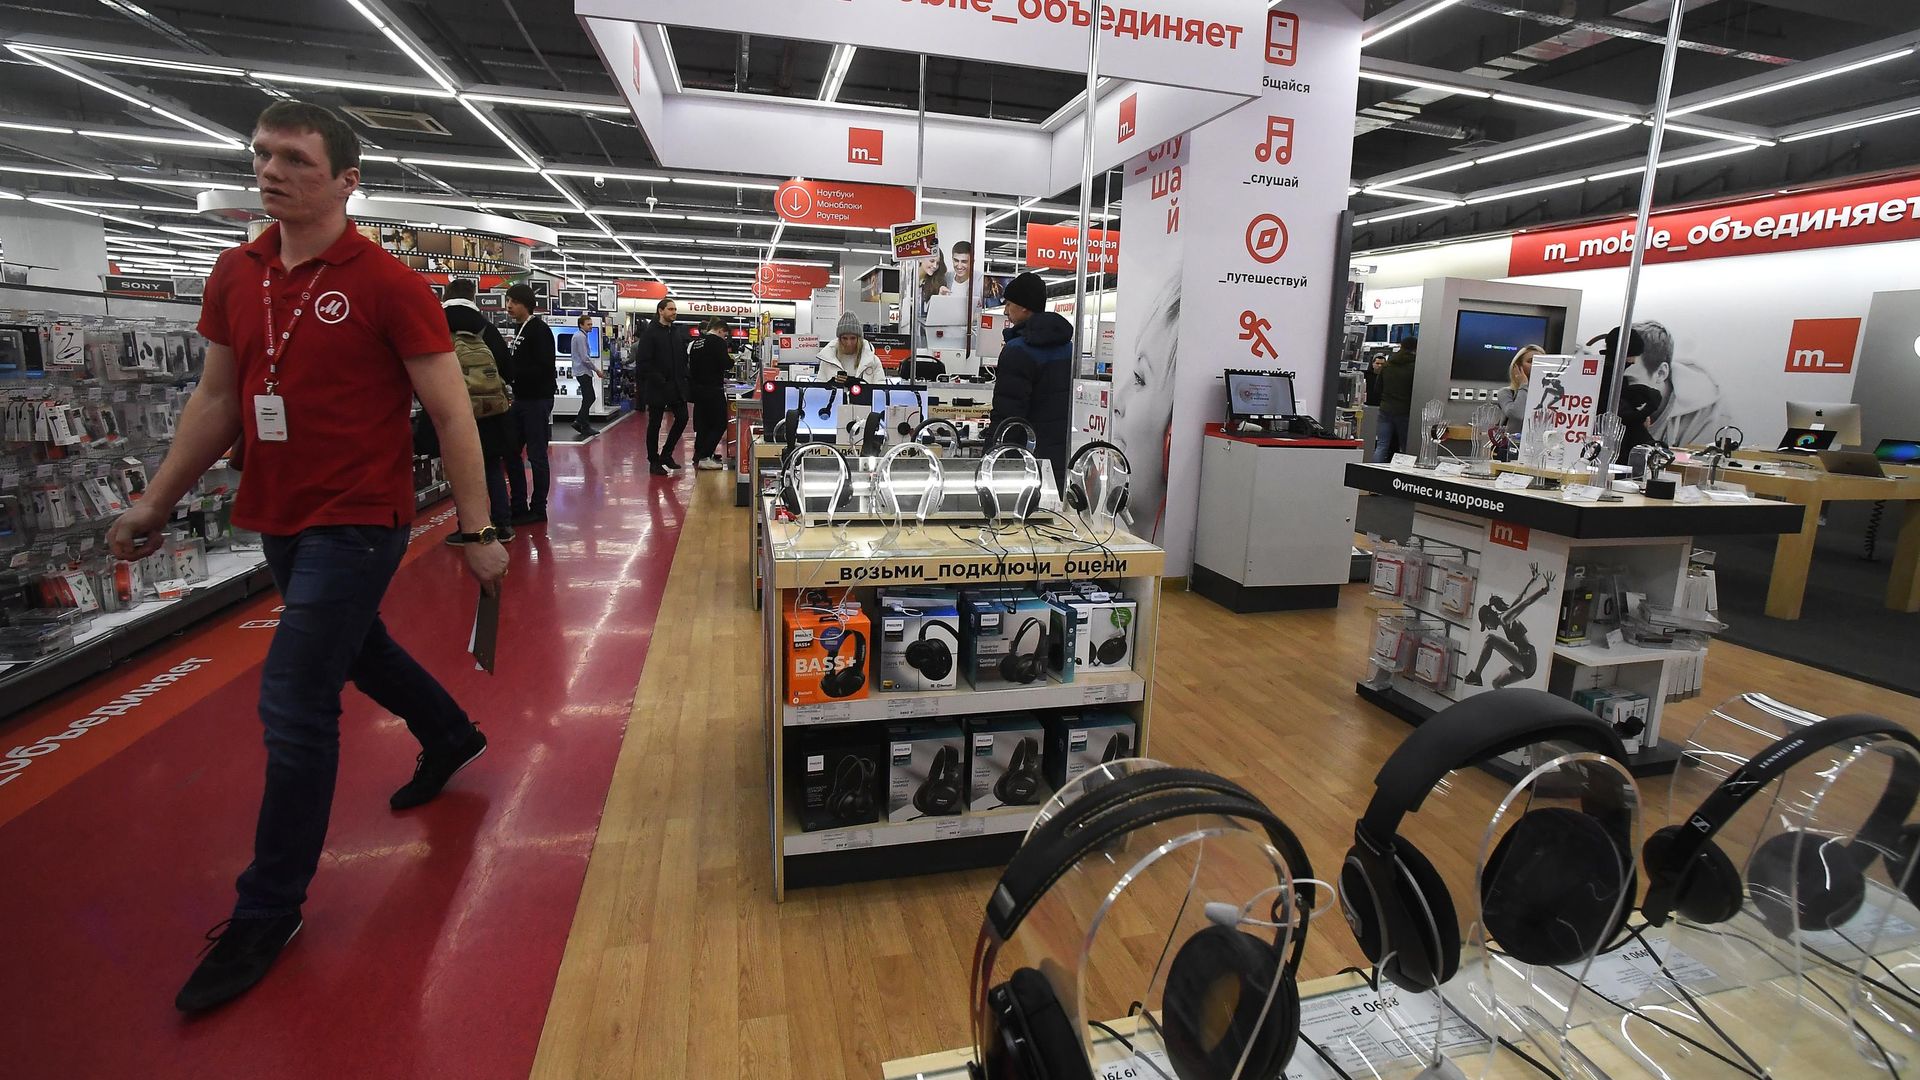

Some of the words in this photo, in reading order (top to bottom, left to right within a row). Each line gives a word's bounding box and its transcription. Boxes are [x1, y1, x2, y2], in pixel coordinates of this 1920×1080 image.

[1262, 75, 1311, 94] бщайся
[851, 147, 879, 161] m_
[1243, 173, 1300, 189] _слушай
[816, 188, 855, 199] Ноутбуки
[816, 200, 863, 210] Моноблоки
[816, 211, 850, 221] Роутеры
[894, 226, 937, 245] РАССРОЧКА
[1543, 197, 1920, 264] m_moble_объединяет
[1063, 237, 1117, 249] цировая
[1037, 248, 1055, 259] по
[121, 281, 160, 290] SONY
[1218, 272, 1308, 288] _путешествуй
[688, 302, 752, 315] Телевизоры
[1054, 302, 1076, 314] Автозву
[1792, 349, 1844, 367] m_
[1392, 477, 1433, 497] Фитнес
[1434, 489, 1443, 499] и
[1445, 490, 1505, 513] здоровье
[1494, 524, 1524, 545] m_
[795, 655, 857, 674] BASS+
